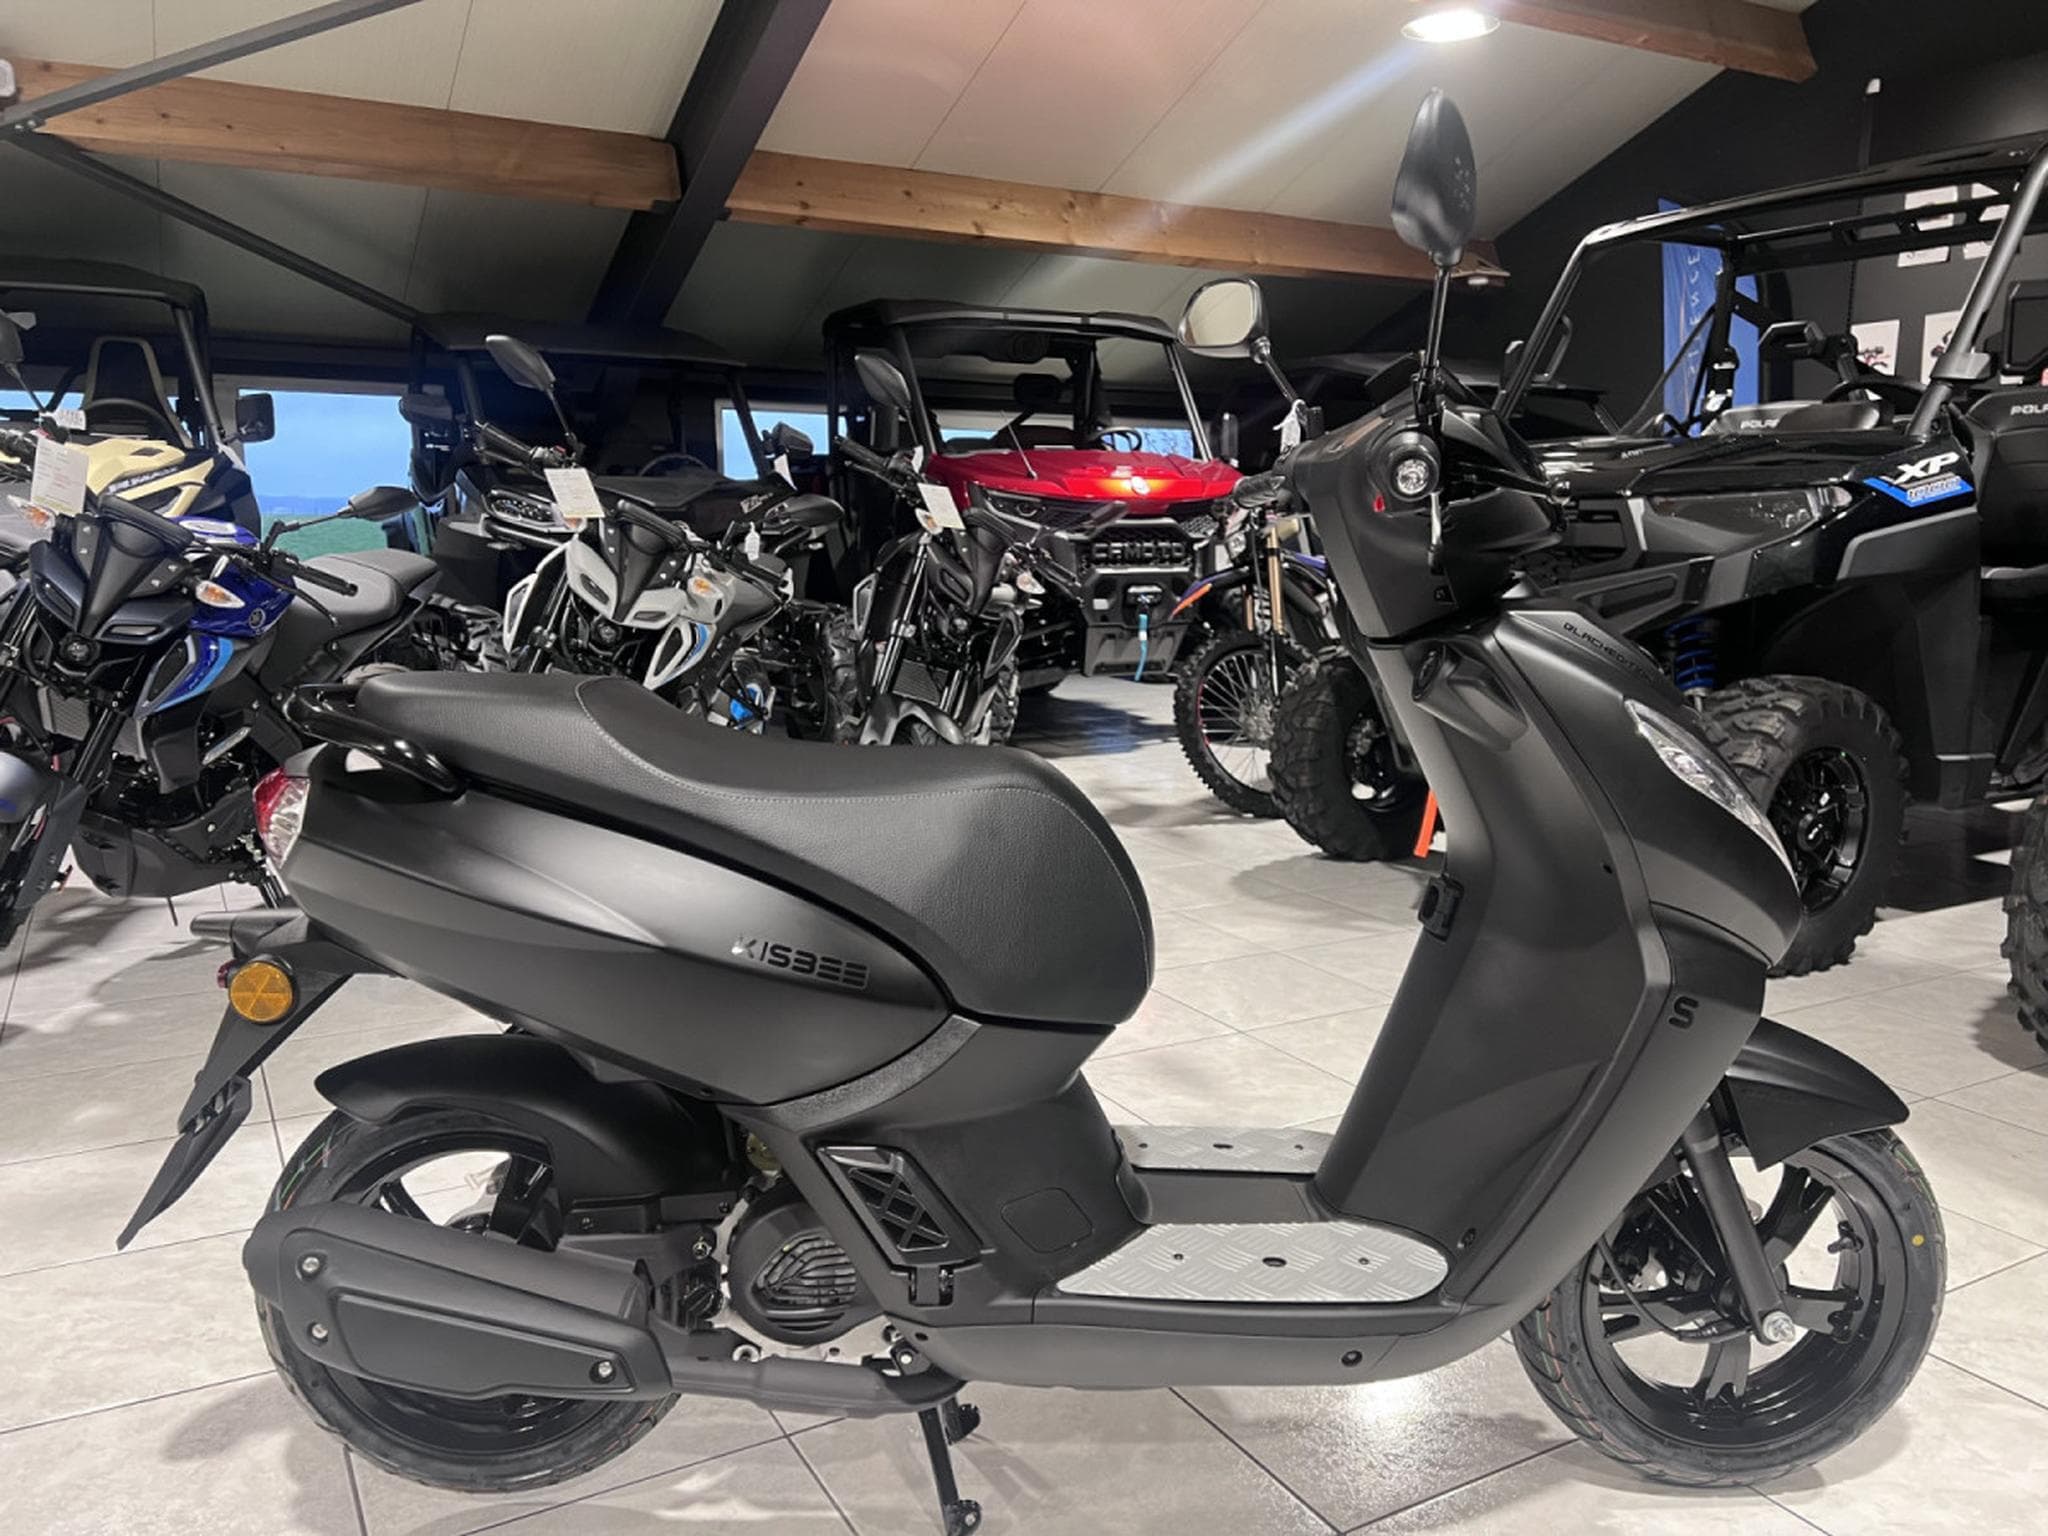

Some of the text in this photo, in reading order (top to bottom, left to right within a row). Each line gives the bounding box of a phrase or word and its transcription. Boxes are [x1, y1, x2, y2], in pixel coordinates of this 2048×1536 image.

[1880, 451, 1960, 485] XP
[1092, 541, 1186, 560] CFMOTO
[732, 935, 869, 988] KISBEE
[1668, 995, 1699, 1030] S
